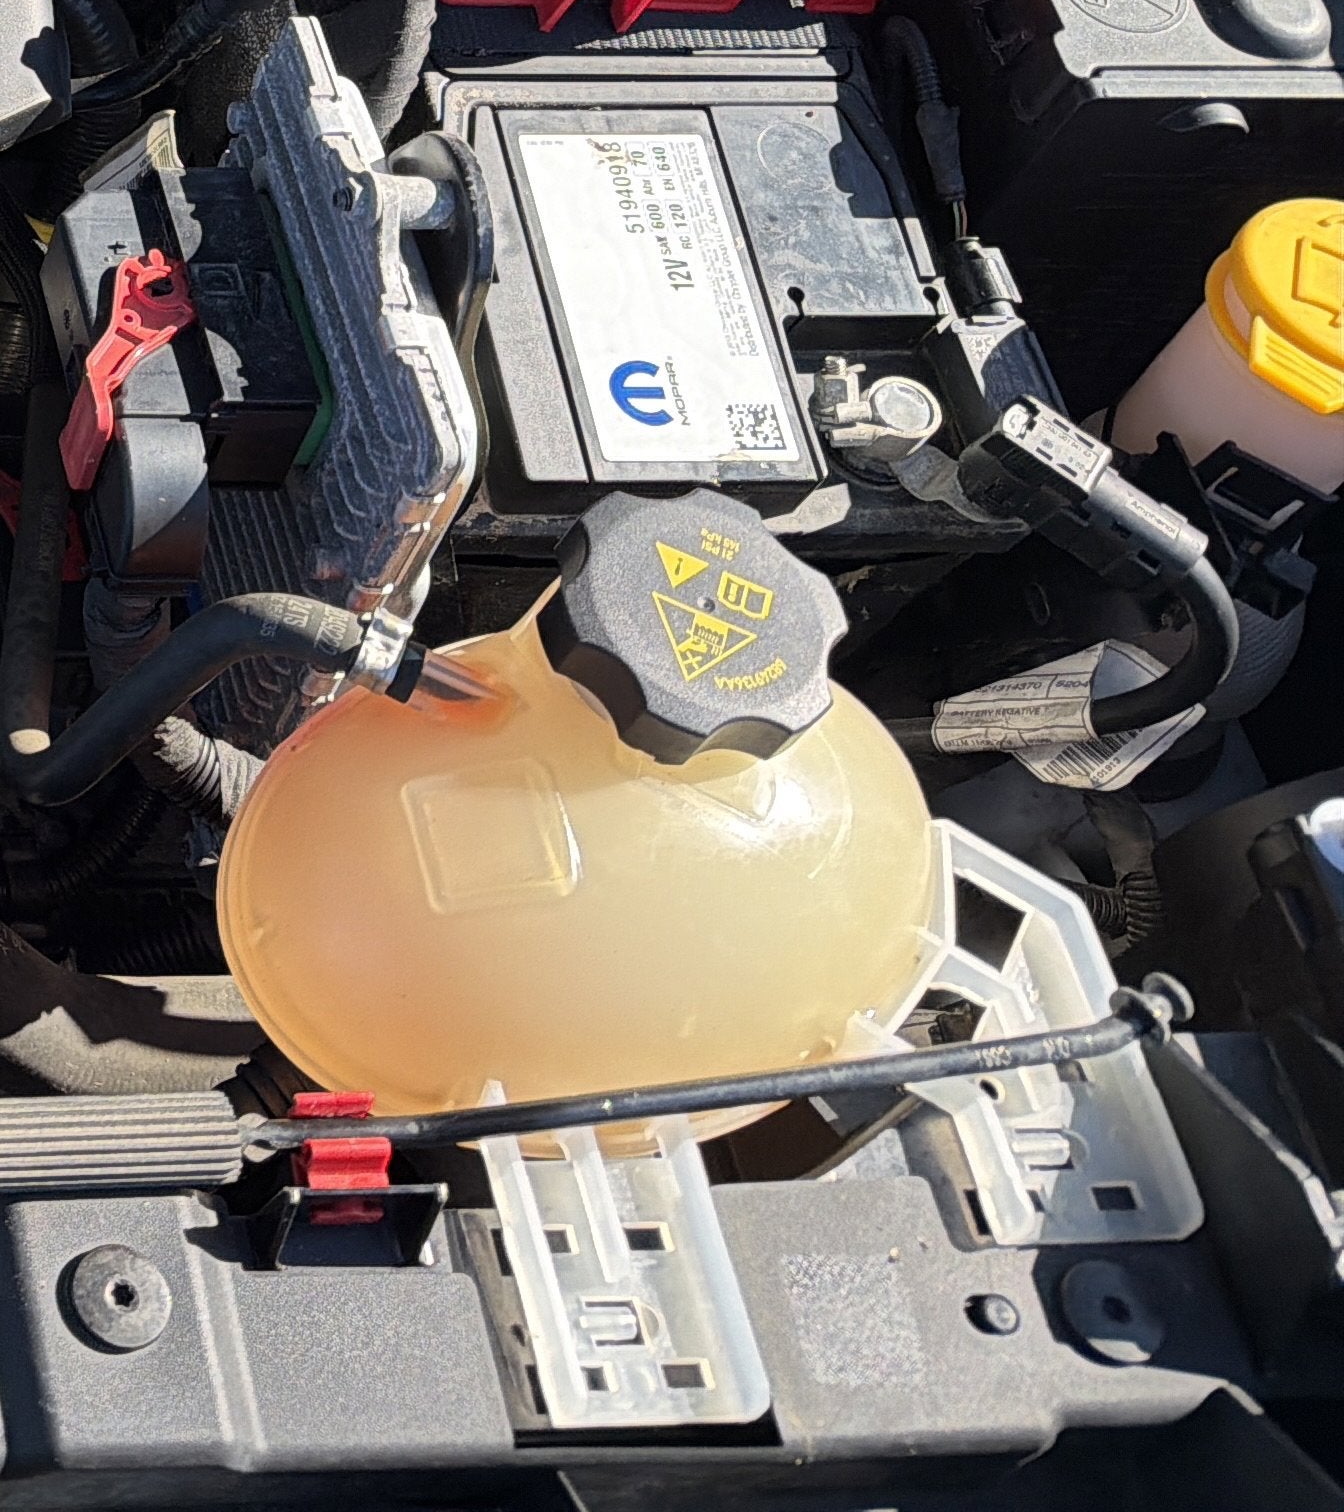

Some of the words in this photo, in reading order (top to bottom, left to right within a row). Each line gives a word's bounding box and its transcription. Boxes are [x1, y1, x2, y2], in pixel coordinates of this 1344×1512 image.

[631, 149, 646, 172] 70
[653, 146, 673, 173] 640
[647, 202, 665, 231] 600
[670, 202, 688, 230] 120
[663, 258, 695, 292] 12V
